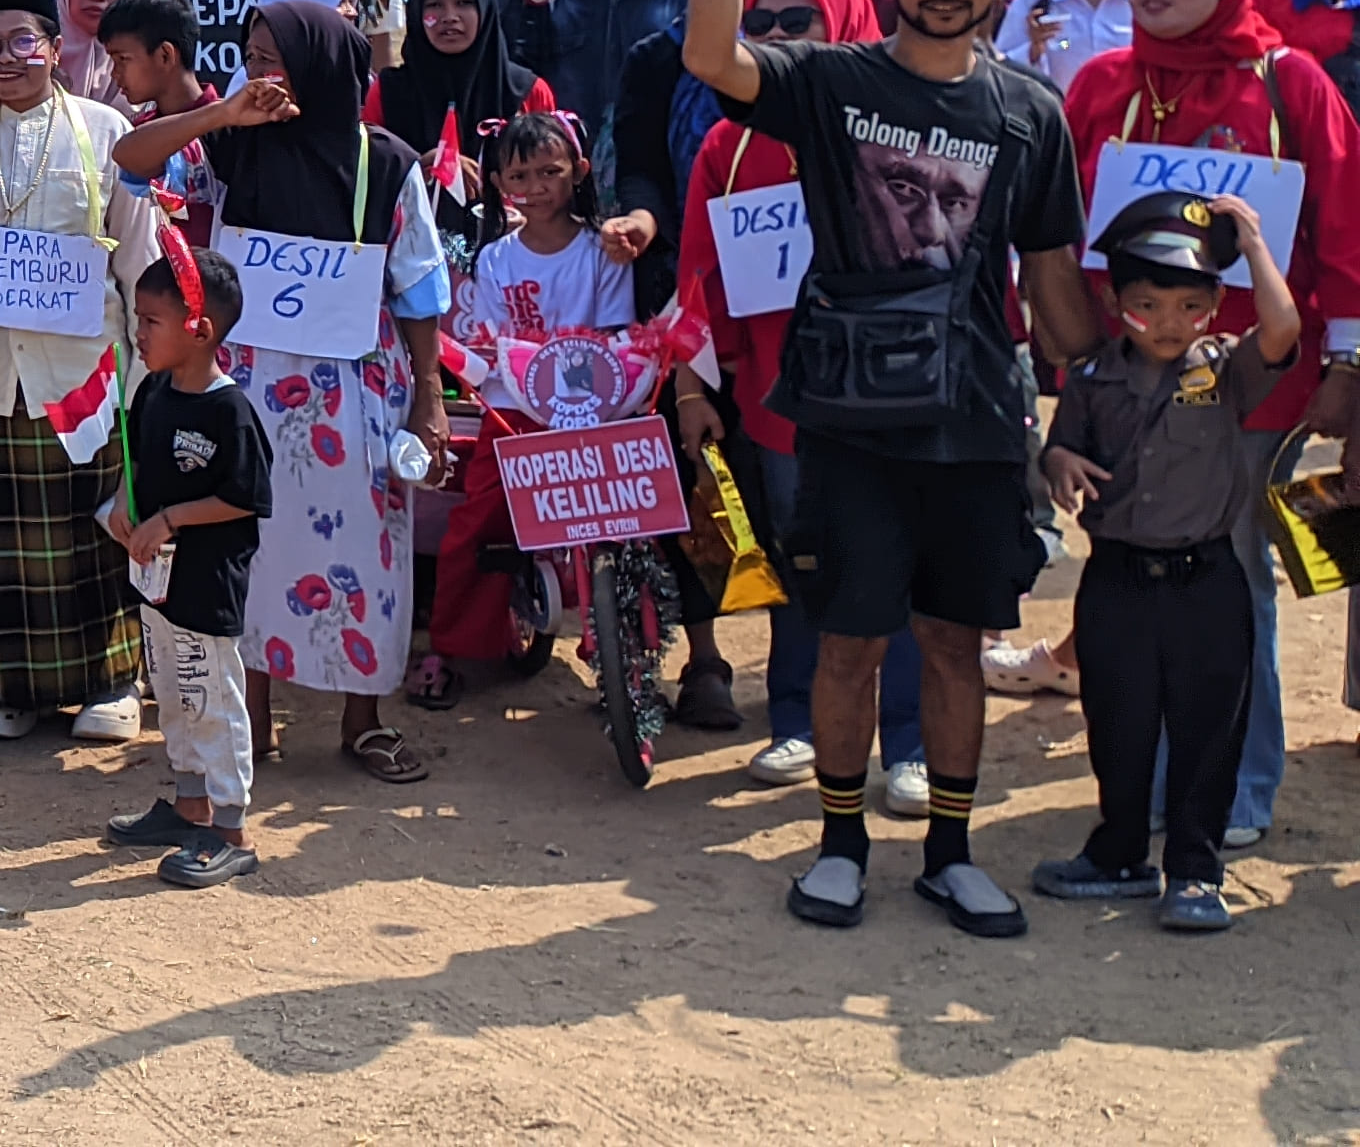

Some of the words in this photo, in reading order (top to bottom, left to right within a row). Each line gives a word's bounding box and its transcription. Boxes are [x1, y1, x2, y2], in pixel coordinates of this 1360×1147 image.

[194, 40, 242, 73] KO
[843, 105, 922, 158] Tolong
[927, 127, 1000, 169] Denga
[1130, 154, 1253, 196] DESIL
[4, 231, 62, 259] PARA
[243, 236, 347, 278] DESIL
[777, 242, 789, 280] 1
[273, 282, 306, 318] 6
[546, 394, 603, 415] KOPDES
[548, 412, 600, 430] KOPO
[502, 444, 606, 489] KOPERASI
[612, 436, 671, 475] DESA
[532, 476, 658, 522] KELILING
[566, 521, 600, 540] INCES
[605, 517, 640, 534] EVRIN
